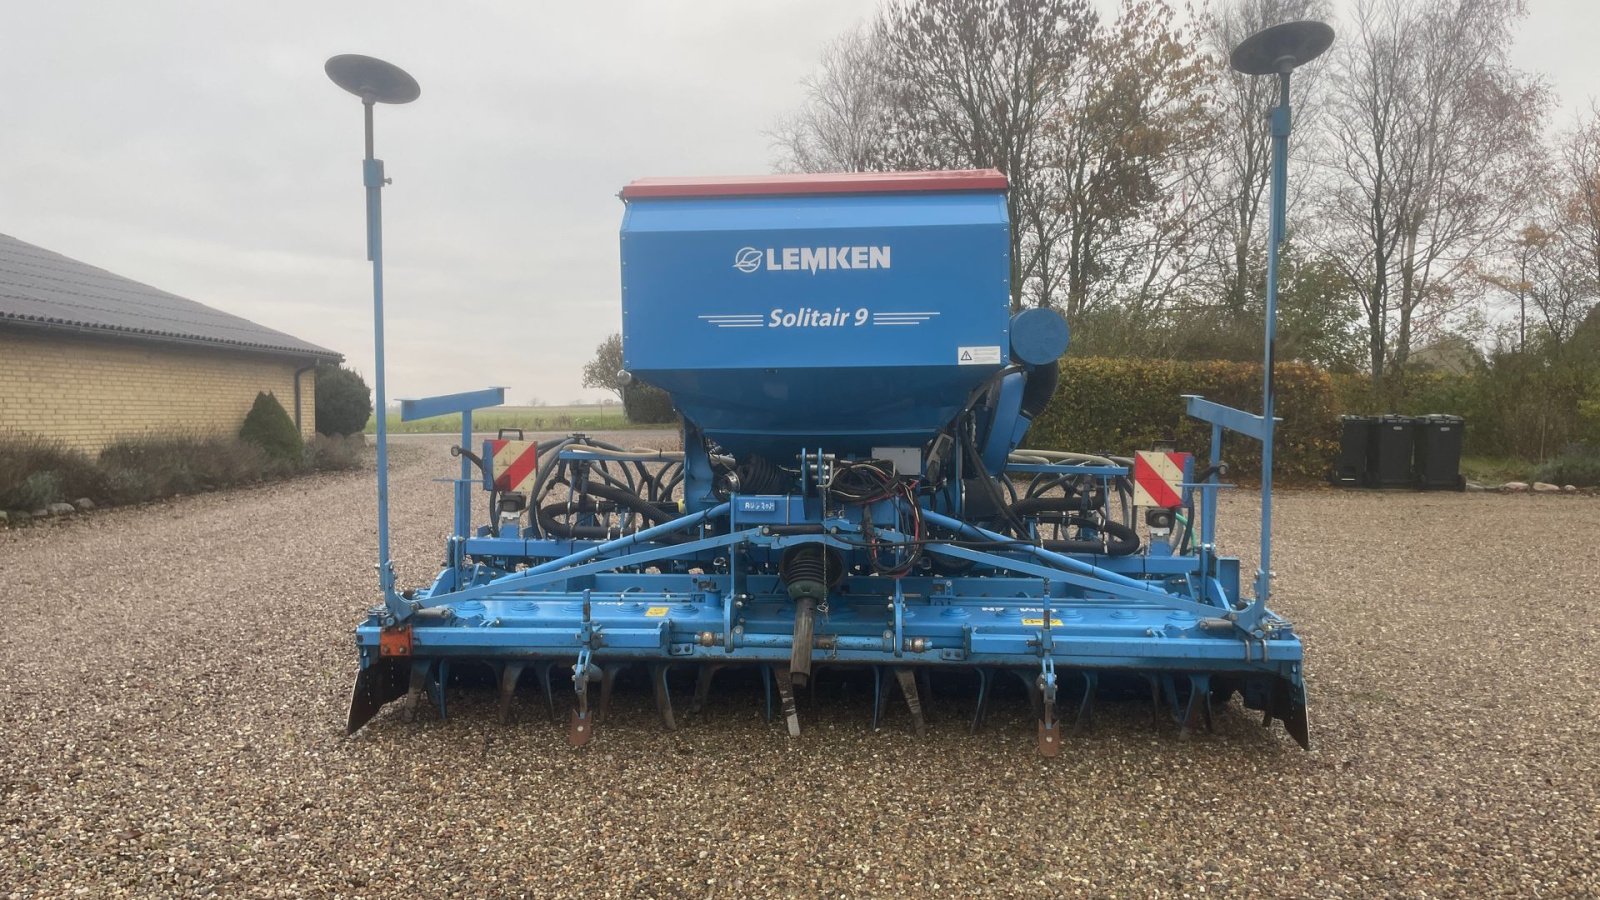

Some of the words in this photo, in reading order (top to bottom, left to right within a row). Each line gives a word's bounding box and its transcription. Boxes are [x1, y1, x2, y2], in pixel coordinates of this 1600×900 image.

[766, 246, 891, 276] LEMKEN
[768, 307, 850, 328] Solitair
[854, 308, 869, 326] 9
